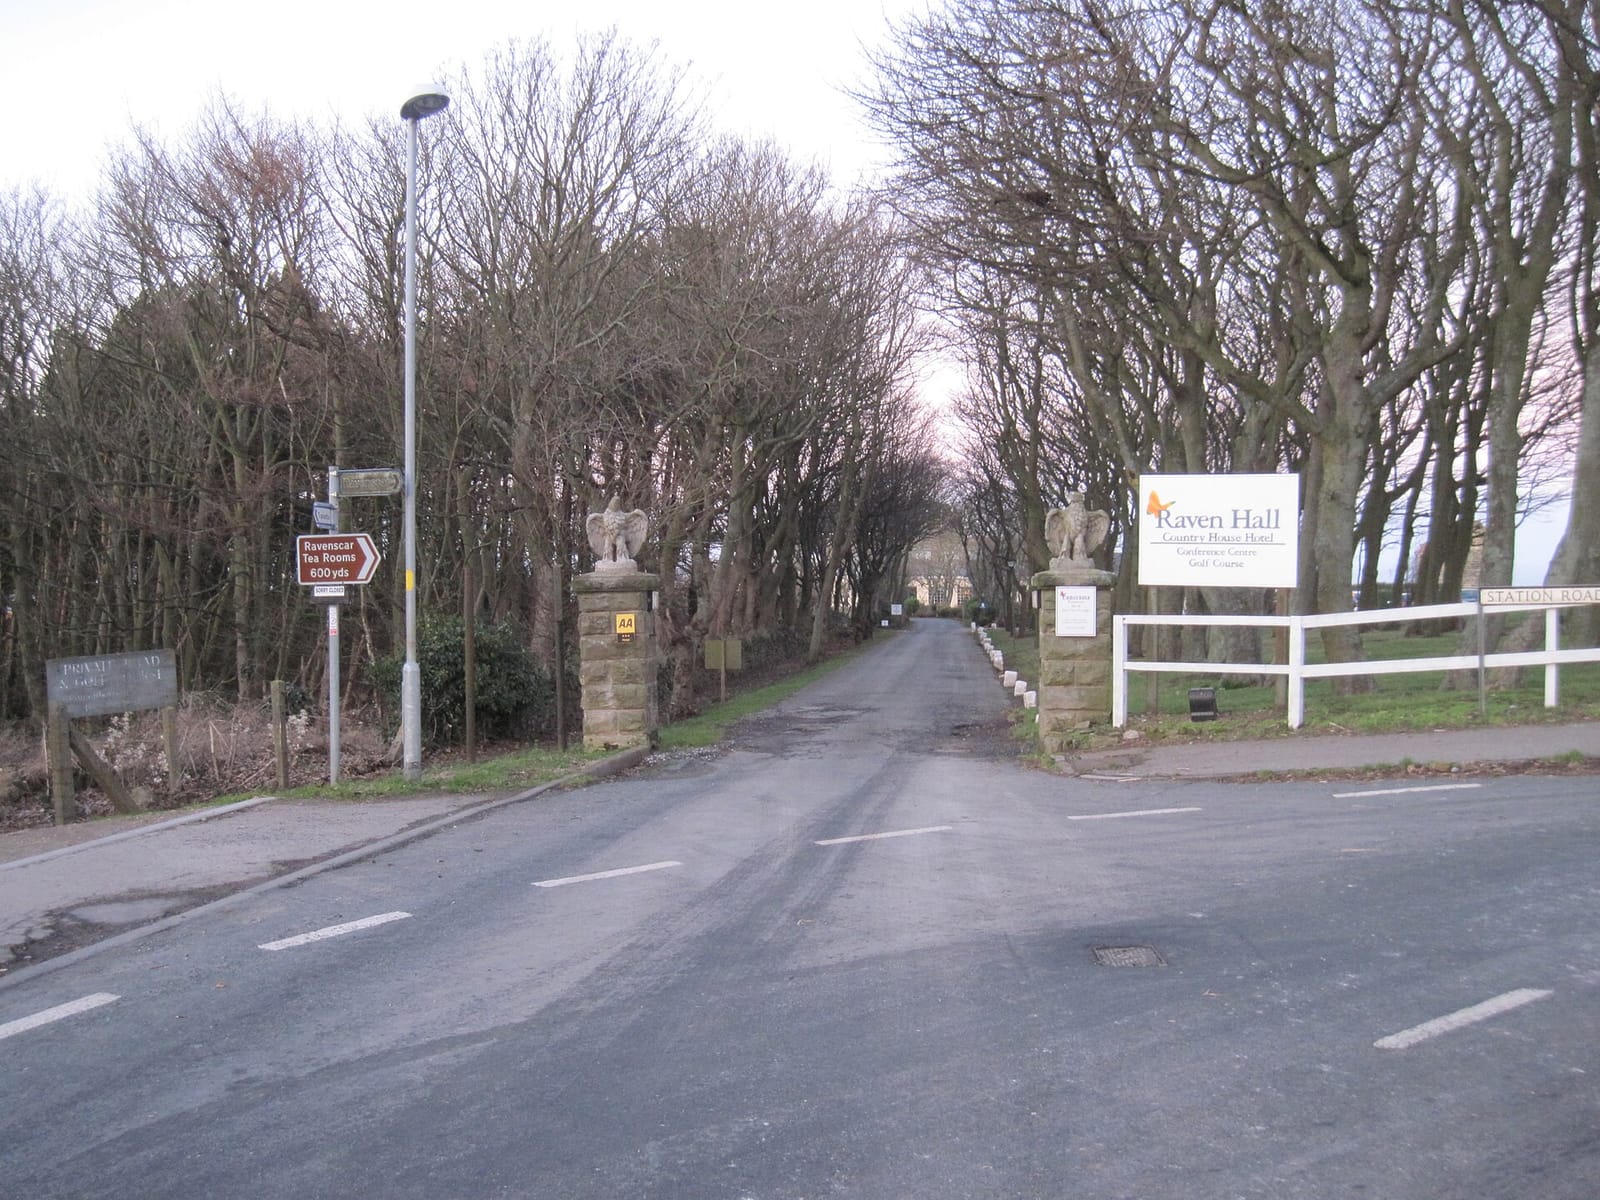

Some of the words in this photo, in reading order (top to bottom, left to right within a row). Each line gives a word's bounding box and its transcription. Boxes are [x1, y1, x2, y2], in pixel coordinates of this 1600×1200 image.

[1155, 508, 1224, 529] Raven
[1230, 508, 1281, 529] Hall
[1162, 532, 1205, 544] Country
[1208, 532, 1242, 543] House
[1245, 532, 1274, 543] Hotel
[304, 541, 354, 551] Ravenscar
[1176, 546, 1226, 557] Conference
[1227, 546, 1257, 557] Centre
[302, 553, 320, 563] Tea
[323, 552, 356, 563] Rooms
[1188, 558, 1209, 569] Golf
[1212, 558, 1244, 568] Course
[310, 567, 331, 578] 600
[331, 567, 350, 579] yds
[1487, 589, 1553, 603] STATION
[618, 618, 633, 628] AA
